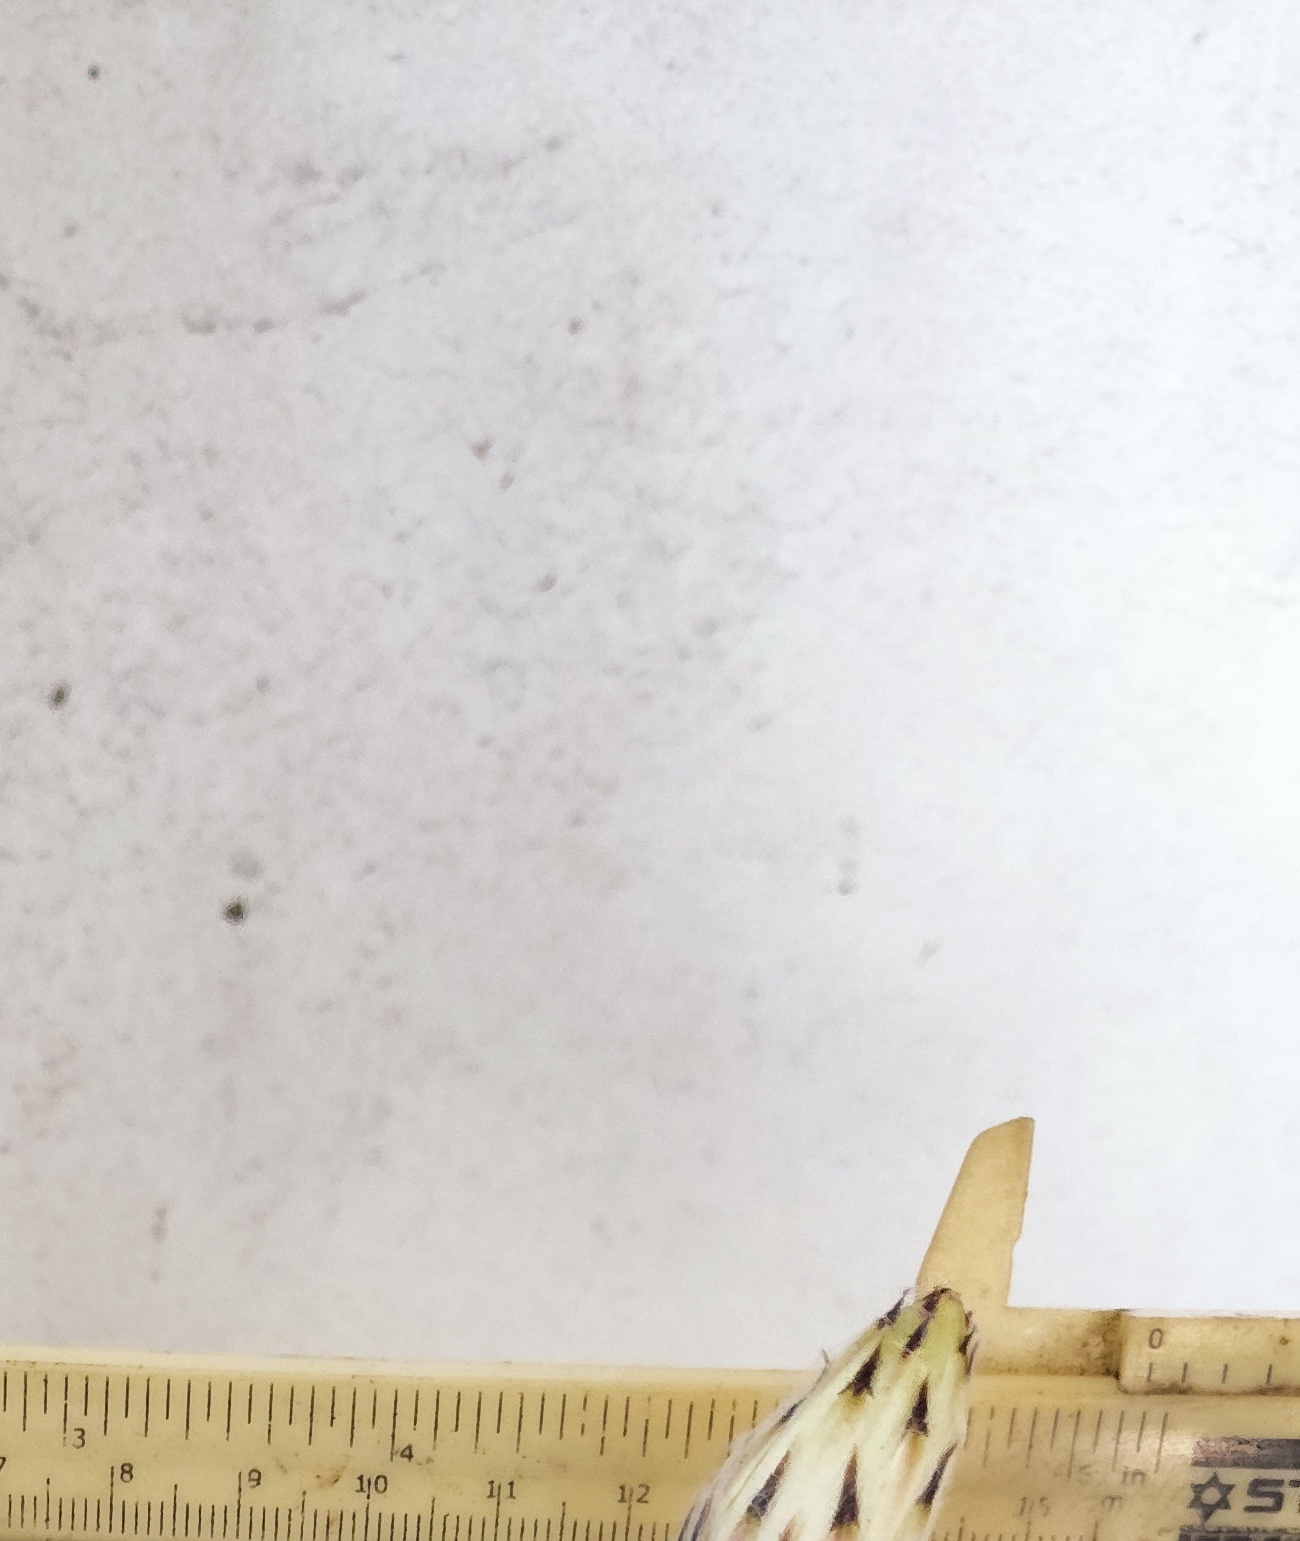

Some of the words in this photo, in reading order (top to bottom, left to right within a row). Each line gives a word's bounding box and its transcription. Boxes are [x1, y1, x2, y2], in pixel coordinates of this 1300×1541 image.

[1148, 1328, 1164, 1349] 0
[72, 1428, 86, 1448] 3
[399, 1443, 414, 1462] 4
[119, 1463, 134, 1483] 8
[247, 1469, 262, 1489] 9
[355, 1474, 388, 1494] 10
[486, 1480, 517, 1500] 11
[618, 1484, 650, 1504] 12
[1243, 1478, 1300, 1513] S
